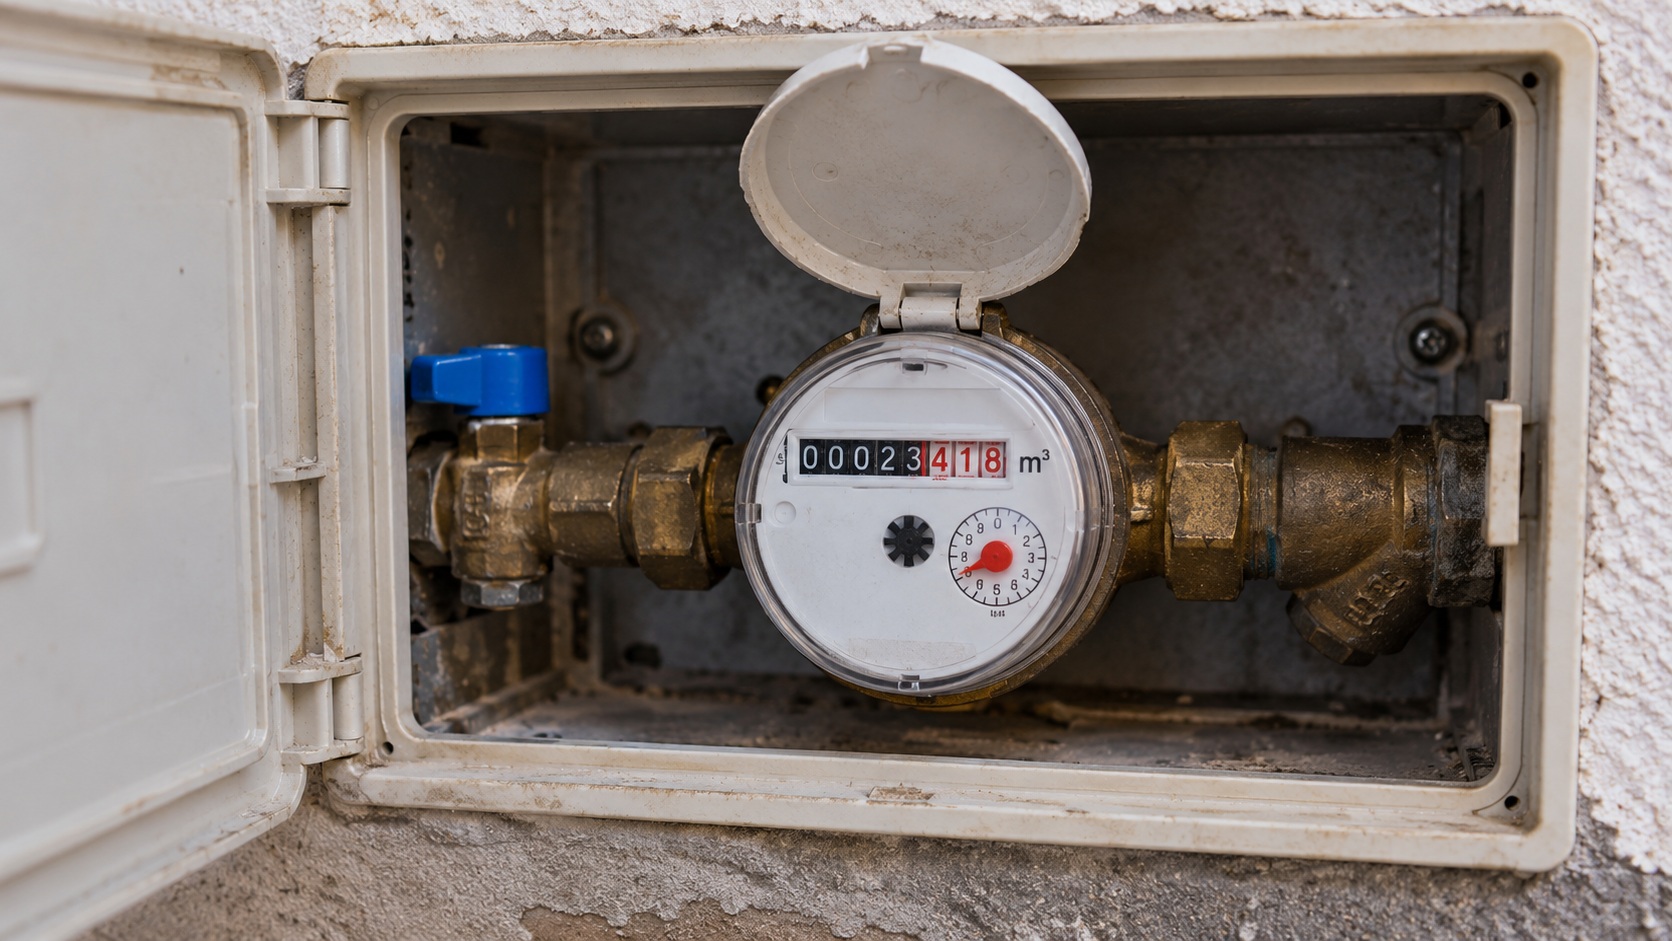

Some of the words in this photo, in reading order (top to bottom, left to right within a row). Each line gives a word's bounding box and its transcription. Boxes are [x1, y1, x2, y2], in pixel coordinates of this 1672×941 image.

[993, 517, 1002, 530] 0
[1012, 524, 1017, 535] 1
[965, 533, 973, 546] 8
[1022, 535, 1031, 547] 2
[960, 551, 968, 562] 8
[1027, 552, 1035, 564] 3
